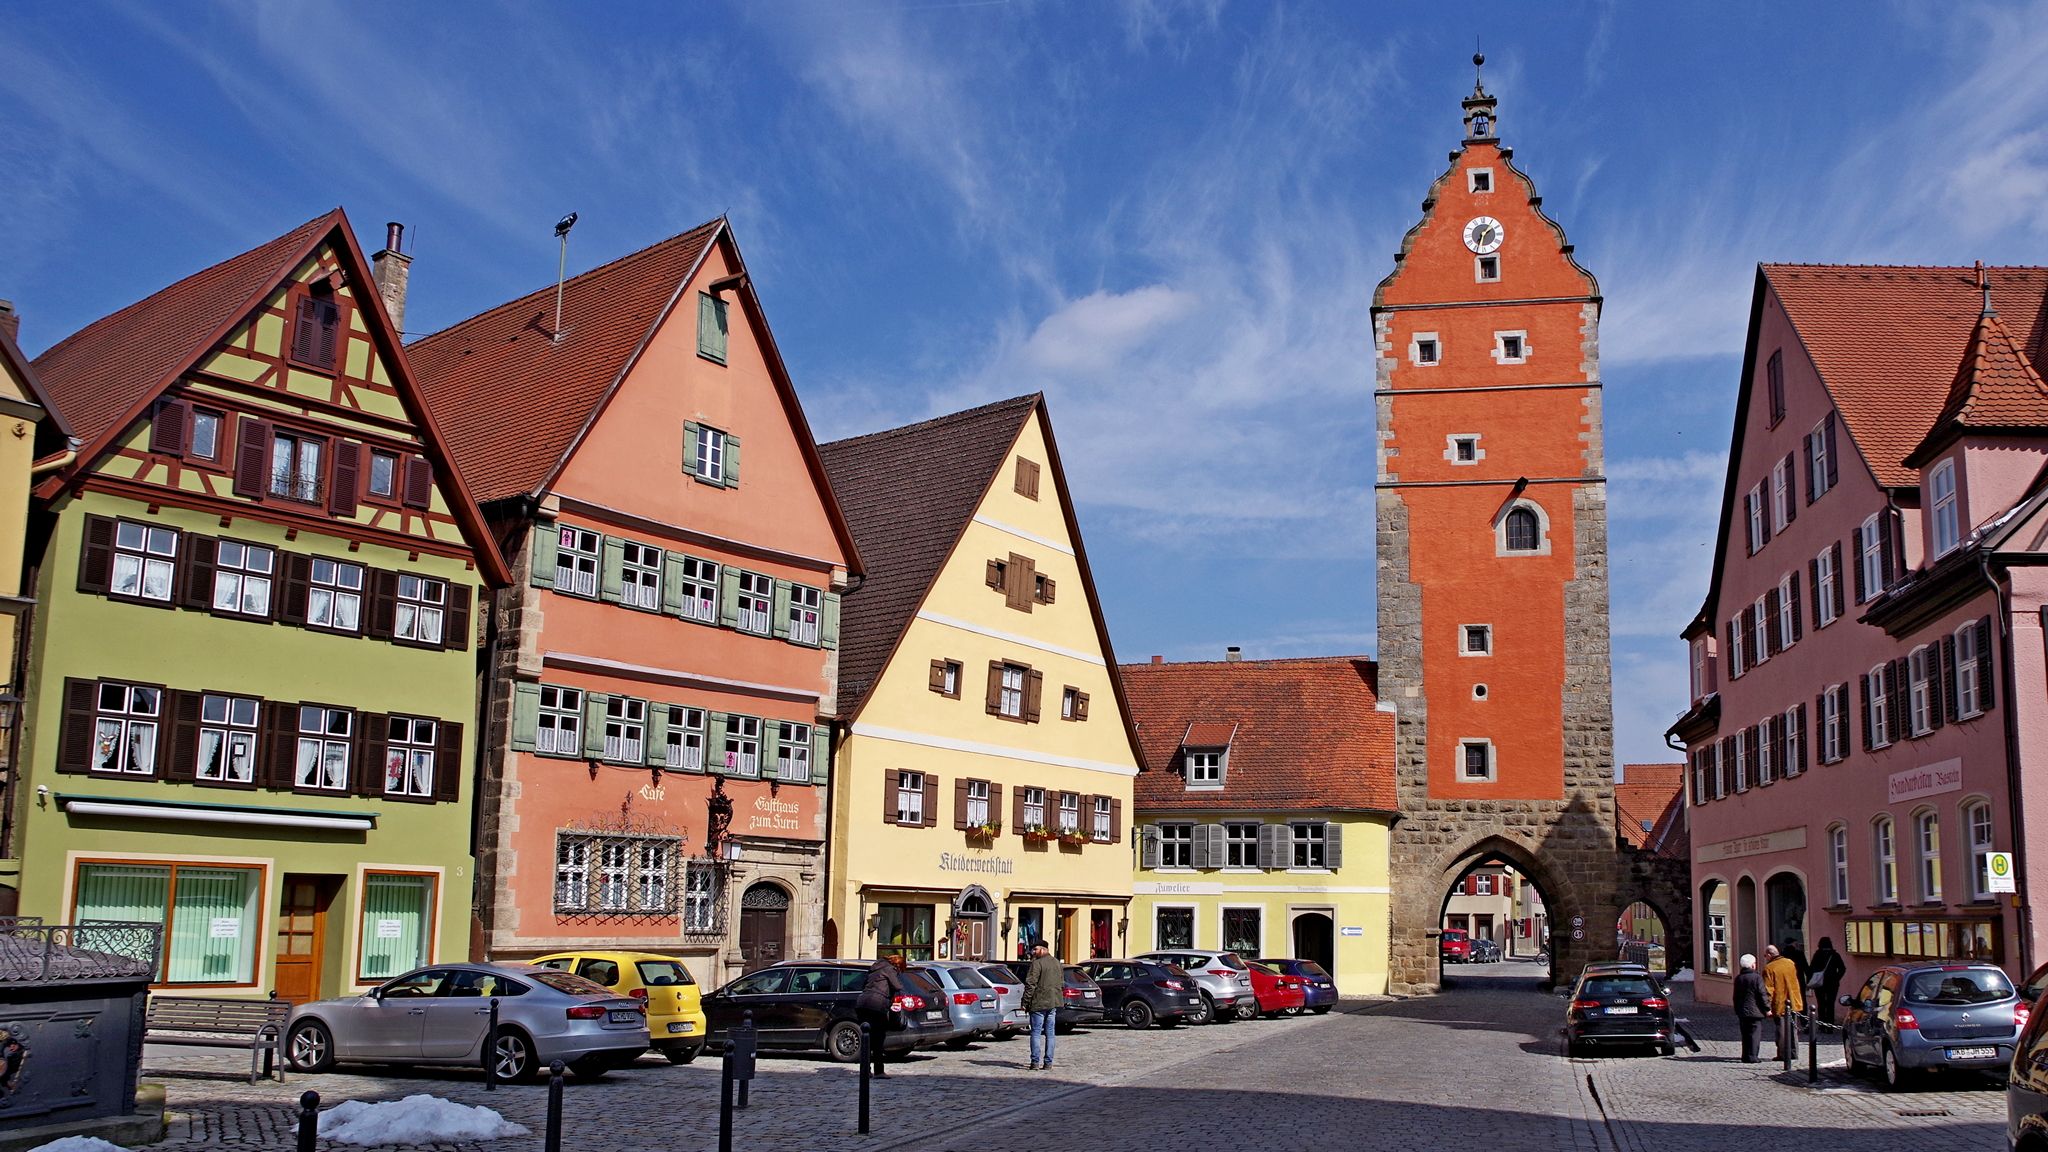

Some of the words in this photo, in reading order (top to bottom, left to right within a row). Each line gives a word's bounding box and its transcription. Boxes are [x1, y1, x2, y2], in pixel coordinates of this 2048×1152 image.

[639, 783, 665, 802] Café
[754, 796, 799, 815] Gasthaus
[750, 814, 772, 830] zum
[456, 865, 464, 877] 3
[939, 852, 1013, 876] Kleiderwerkstatt
[1155, 882, 1191, 894] Juwelier
